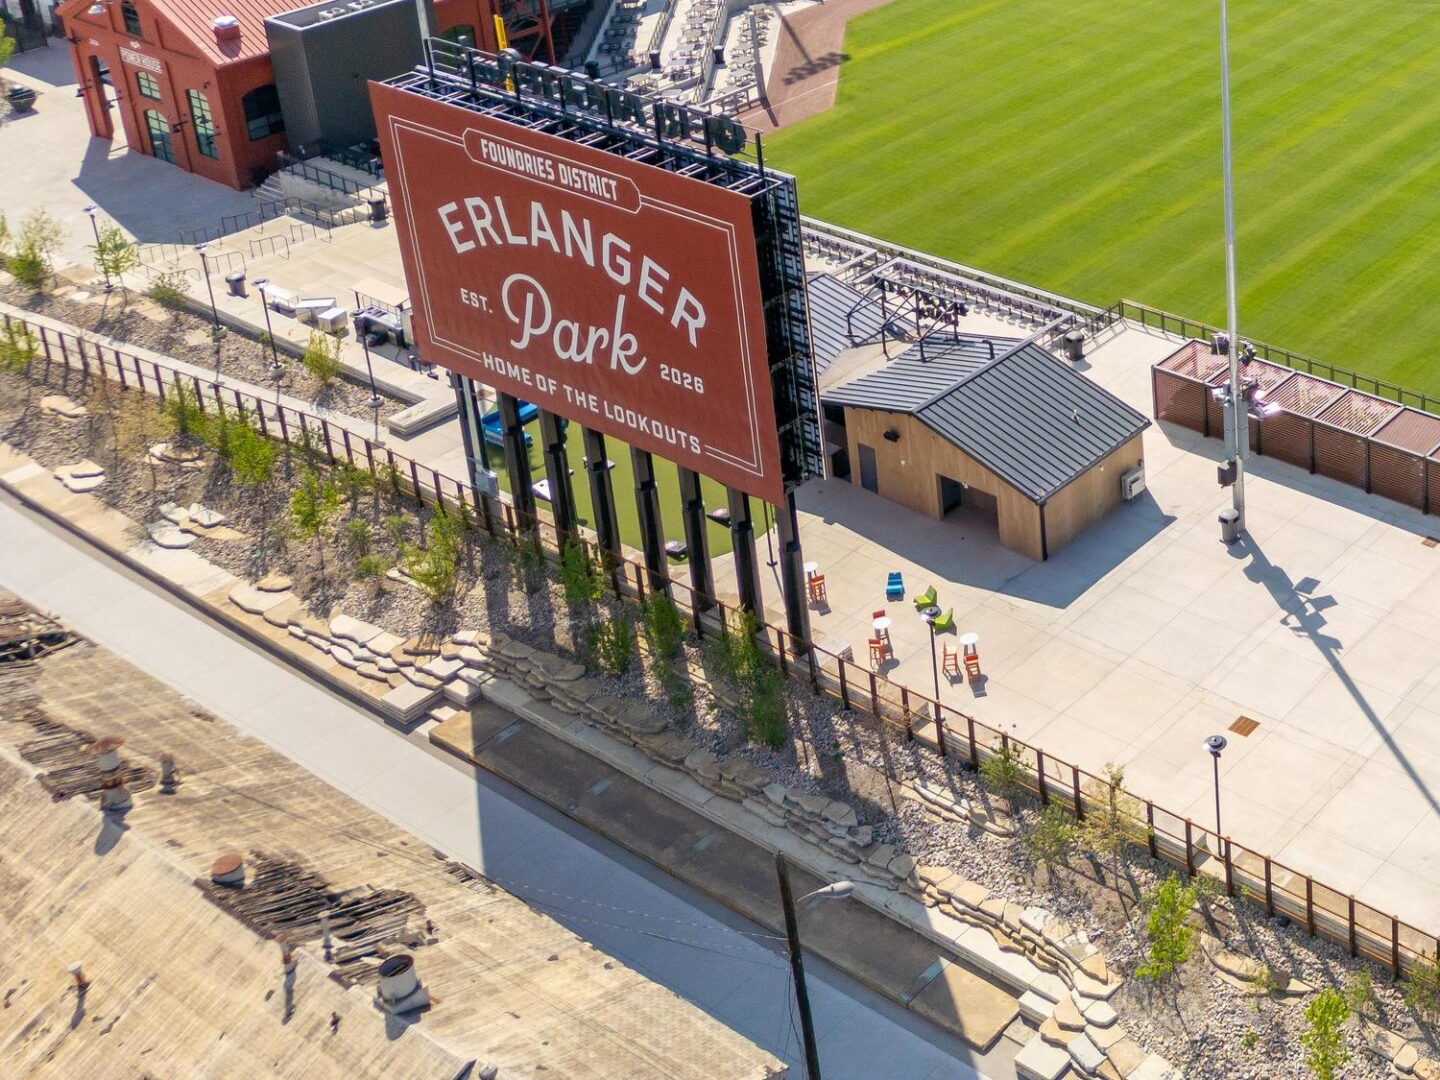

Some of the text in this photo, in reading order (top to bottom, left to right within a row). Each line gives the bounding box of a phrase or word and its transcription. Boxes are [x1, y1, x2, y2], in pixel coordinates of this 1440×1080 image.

[481, 138, 618, 202] FOUNDRIES DISTRICT
[437, 196, 707, 348] ERLANGER
[461, 287, 494, 313] EST.
[501, 273, 647, 376] Park
[483, 351, 701, 454] HOME OF THE LOOKOUTS
[660, 363, 704, 394] 2026
